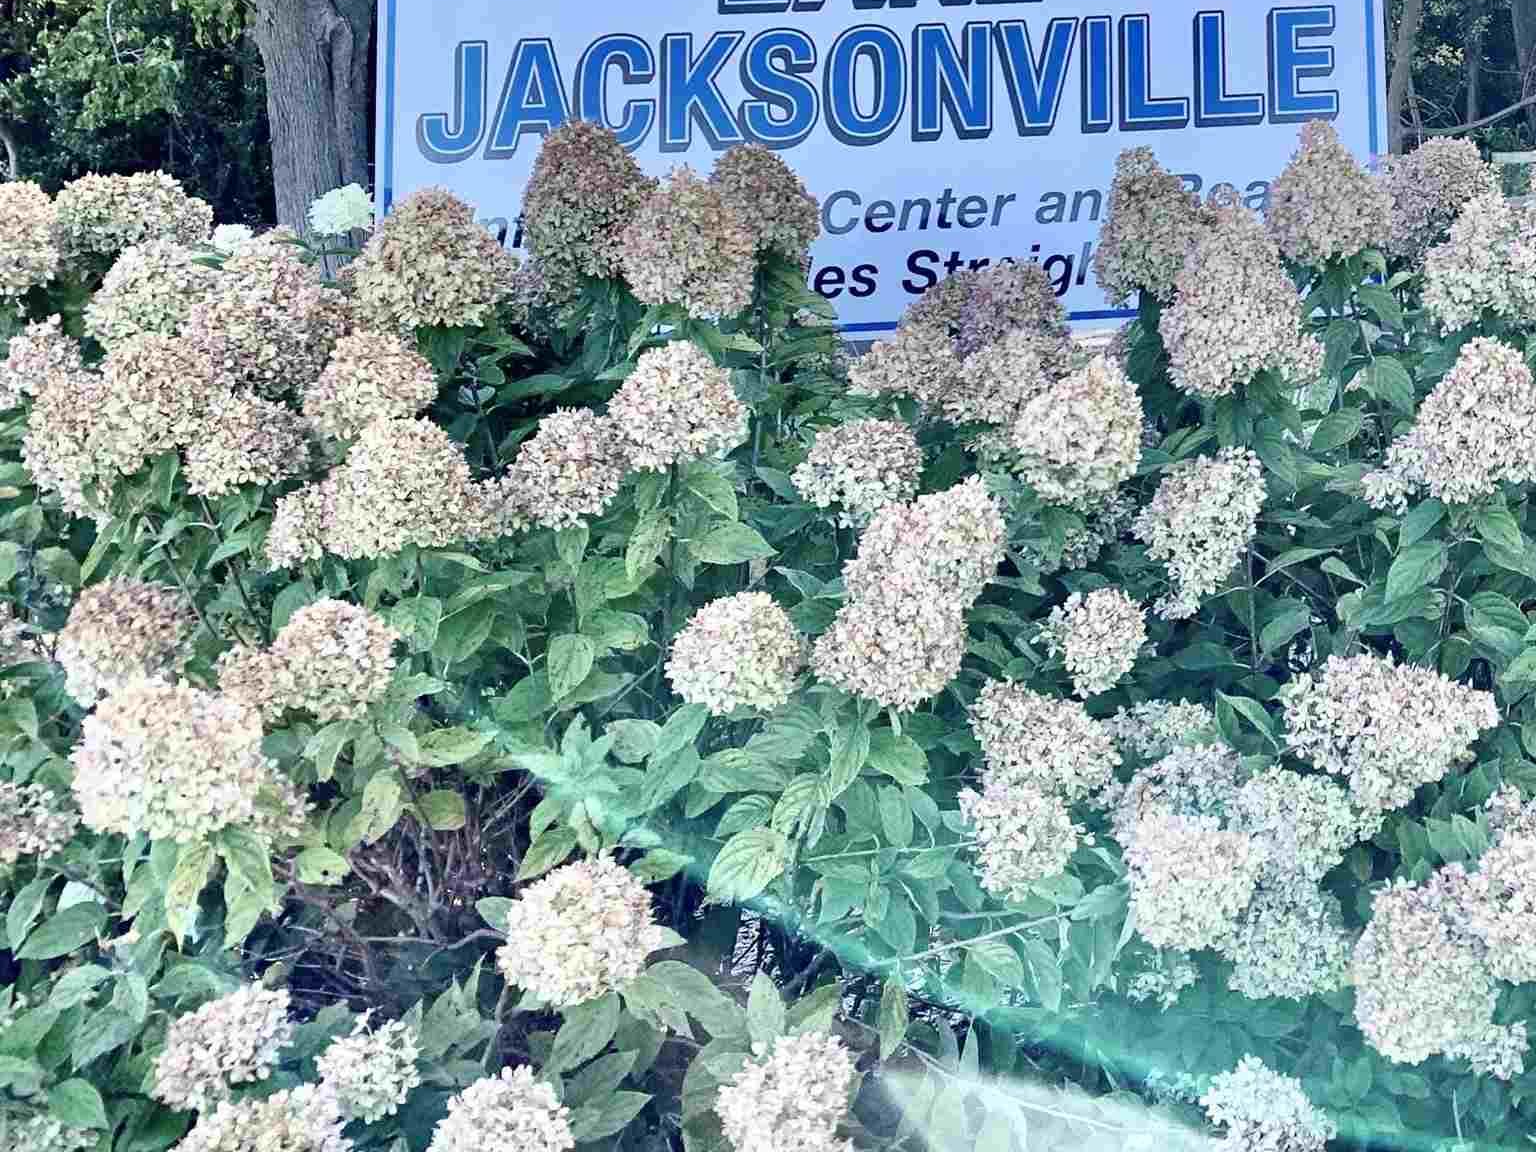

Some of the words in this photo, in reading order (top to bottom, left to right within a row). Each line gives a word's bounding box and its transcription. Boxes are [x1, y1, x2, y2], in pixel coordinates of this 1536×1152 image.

[416, 4, 1337, 164] JACKSONVILLE
[822, 186, 1016, 235] Center
[1035, 186, 1109, 224] an
